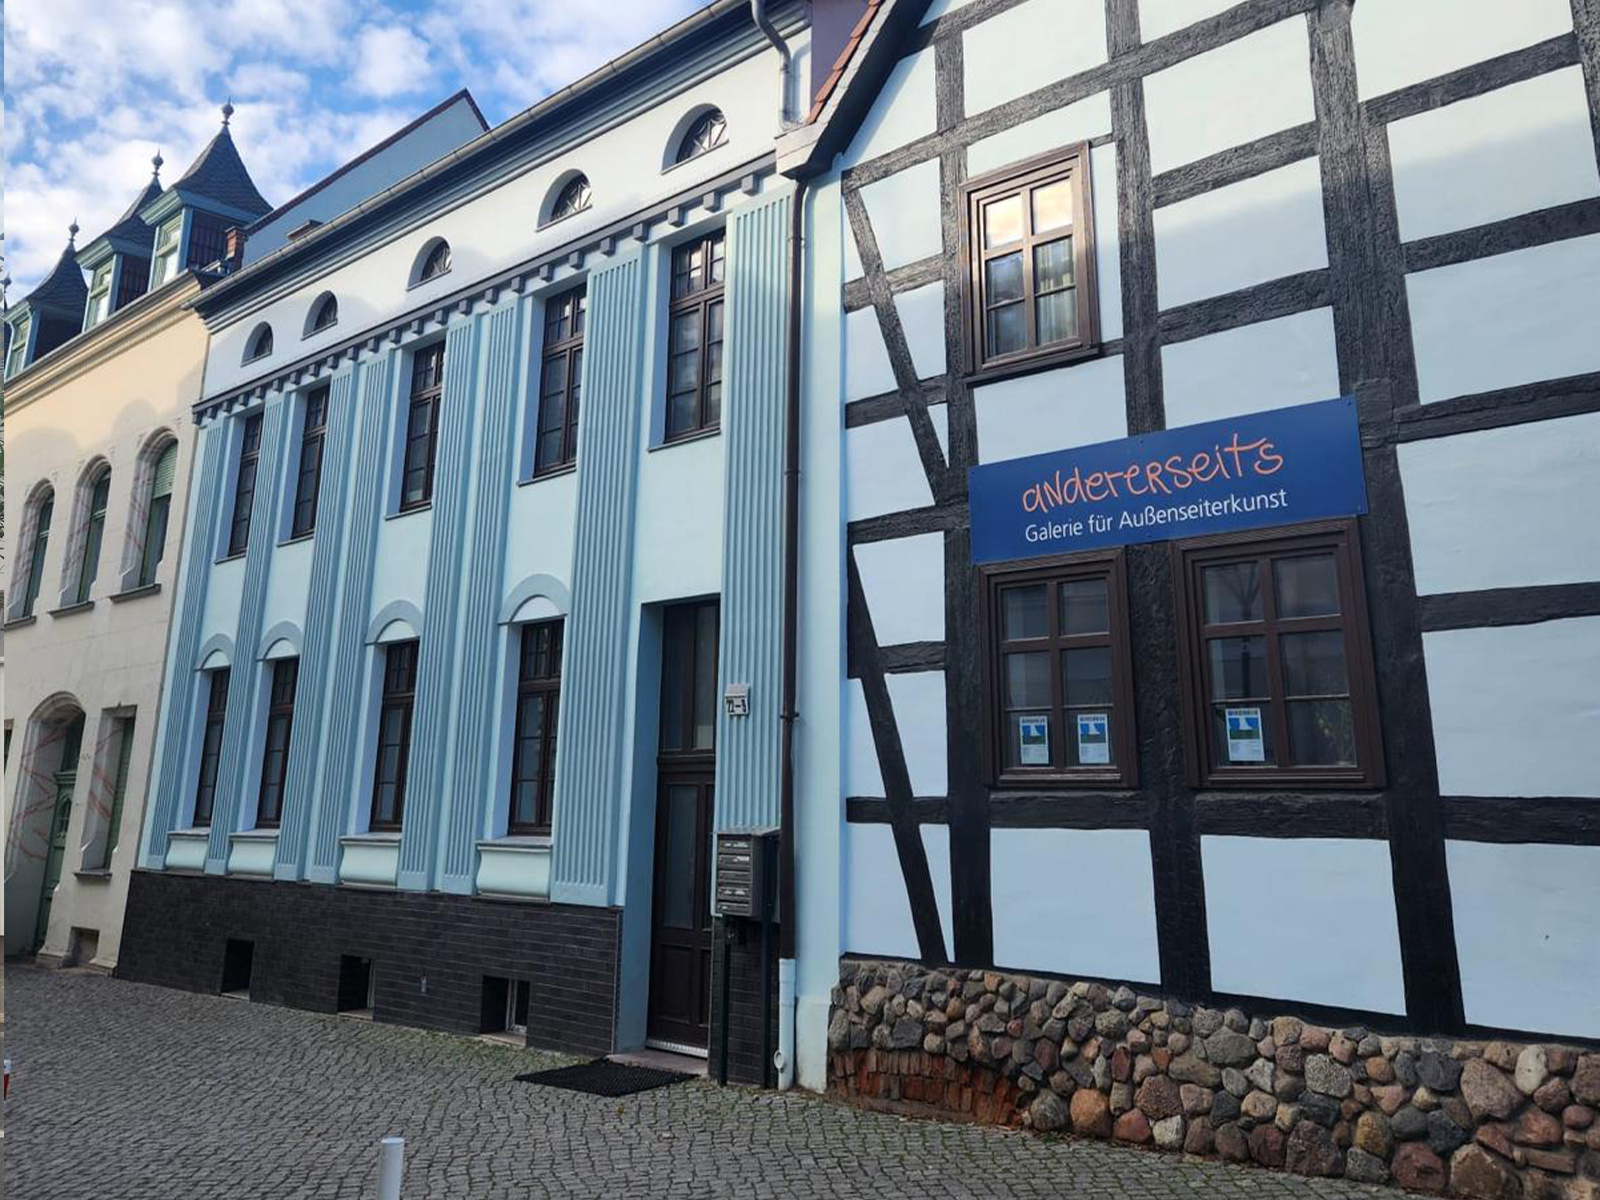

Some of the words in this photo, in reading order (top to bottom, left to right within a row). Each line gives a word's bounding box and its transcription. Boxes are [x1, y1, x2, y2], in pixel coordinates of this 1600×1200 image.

[1025, 521, 1083, 542] Galerie
[1088, 514, 1113, 533] für
[1119, 489, 1289, 529] Außenseiterkunst
